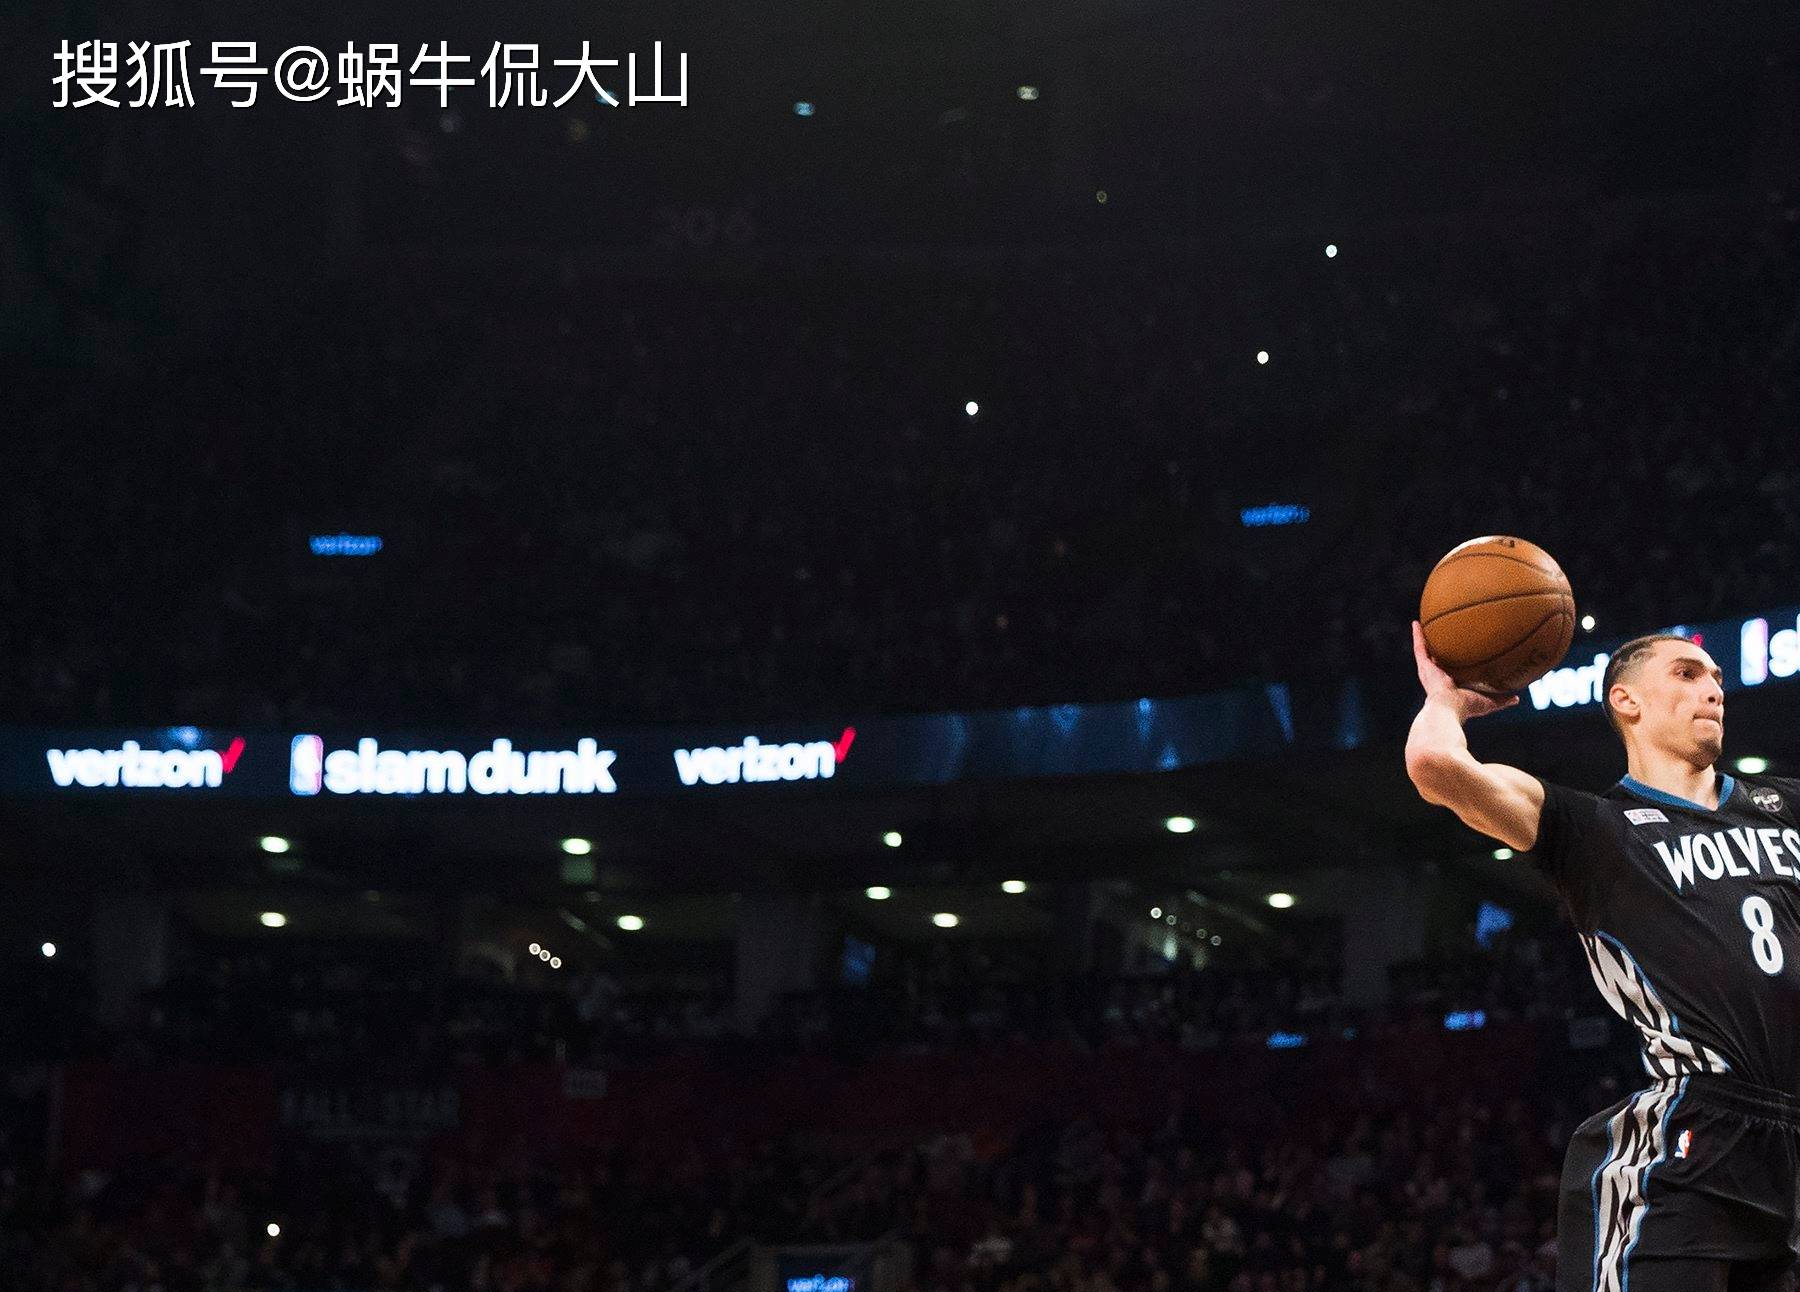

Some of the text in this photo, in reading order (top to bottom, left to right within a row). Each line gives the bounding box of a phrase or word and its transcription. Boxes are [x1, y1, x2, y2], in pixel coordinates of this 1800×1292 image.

[1528, 653, 1611, 710] veri
[46, 740, 224, 788] verizon
[673, 735, 836, 786] verizon
[1741, 895, 1784, 975] 8
